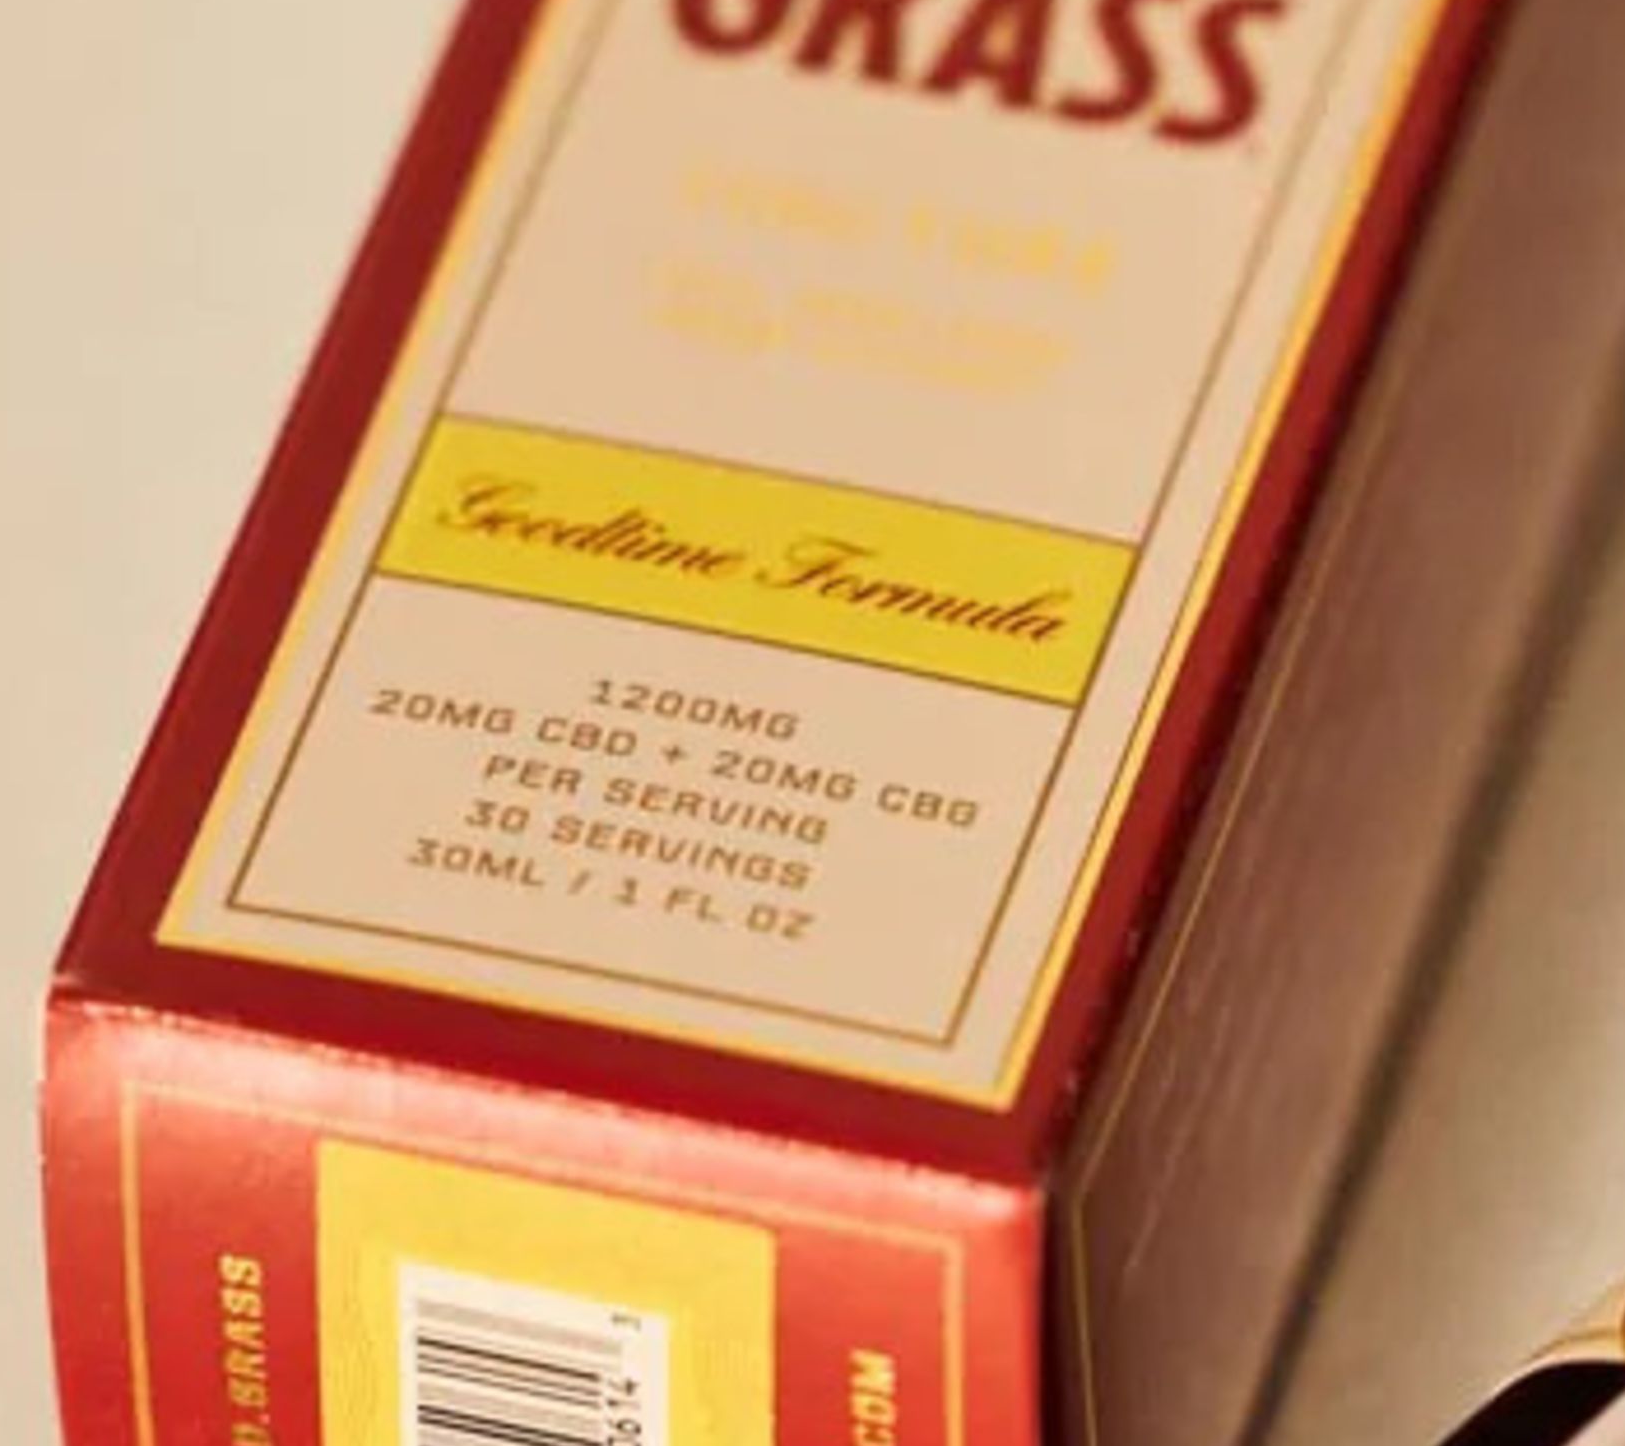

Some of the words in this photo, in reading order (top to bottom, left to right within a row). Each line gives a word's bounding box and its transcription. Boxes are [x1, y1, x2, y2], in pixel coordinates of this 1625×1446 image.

[433, 471, 749, 581] Goodtime
[753, 531, 1073, 643] Formula
[370, 688, 517, 735] 20MG
[535, 716, 638, 758] CBD
[661, 743, 689, 765] +
[710, 750, 859, 802] 20MG
[876, 784, 980, 828] CBG
[590, 678, 800, 741] 1200MG
[463, 799, 531, 835] 30
[549, 813, 813, 891] SERVINGS
[484, 754, 584, 795] PER
[602, 777, 829, 845] SERVING
[406, 837, 546, 888] 30ML
[567, 870, 592, 895] /
[613, 875, 640, 906] 1
[664, 888, 723, 925] FL
[744, 904, 816, 940] OZ
